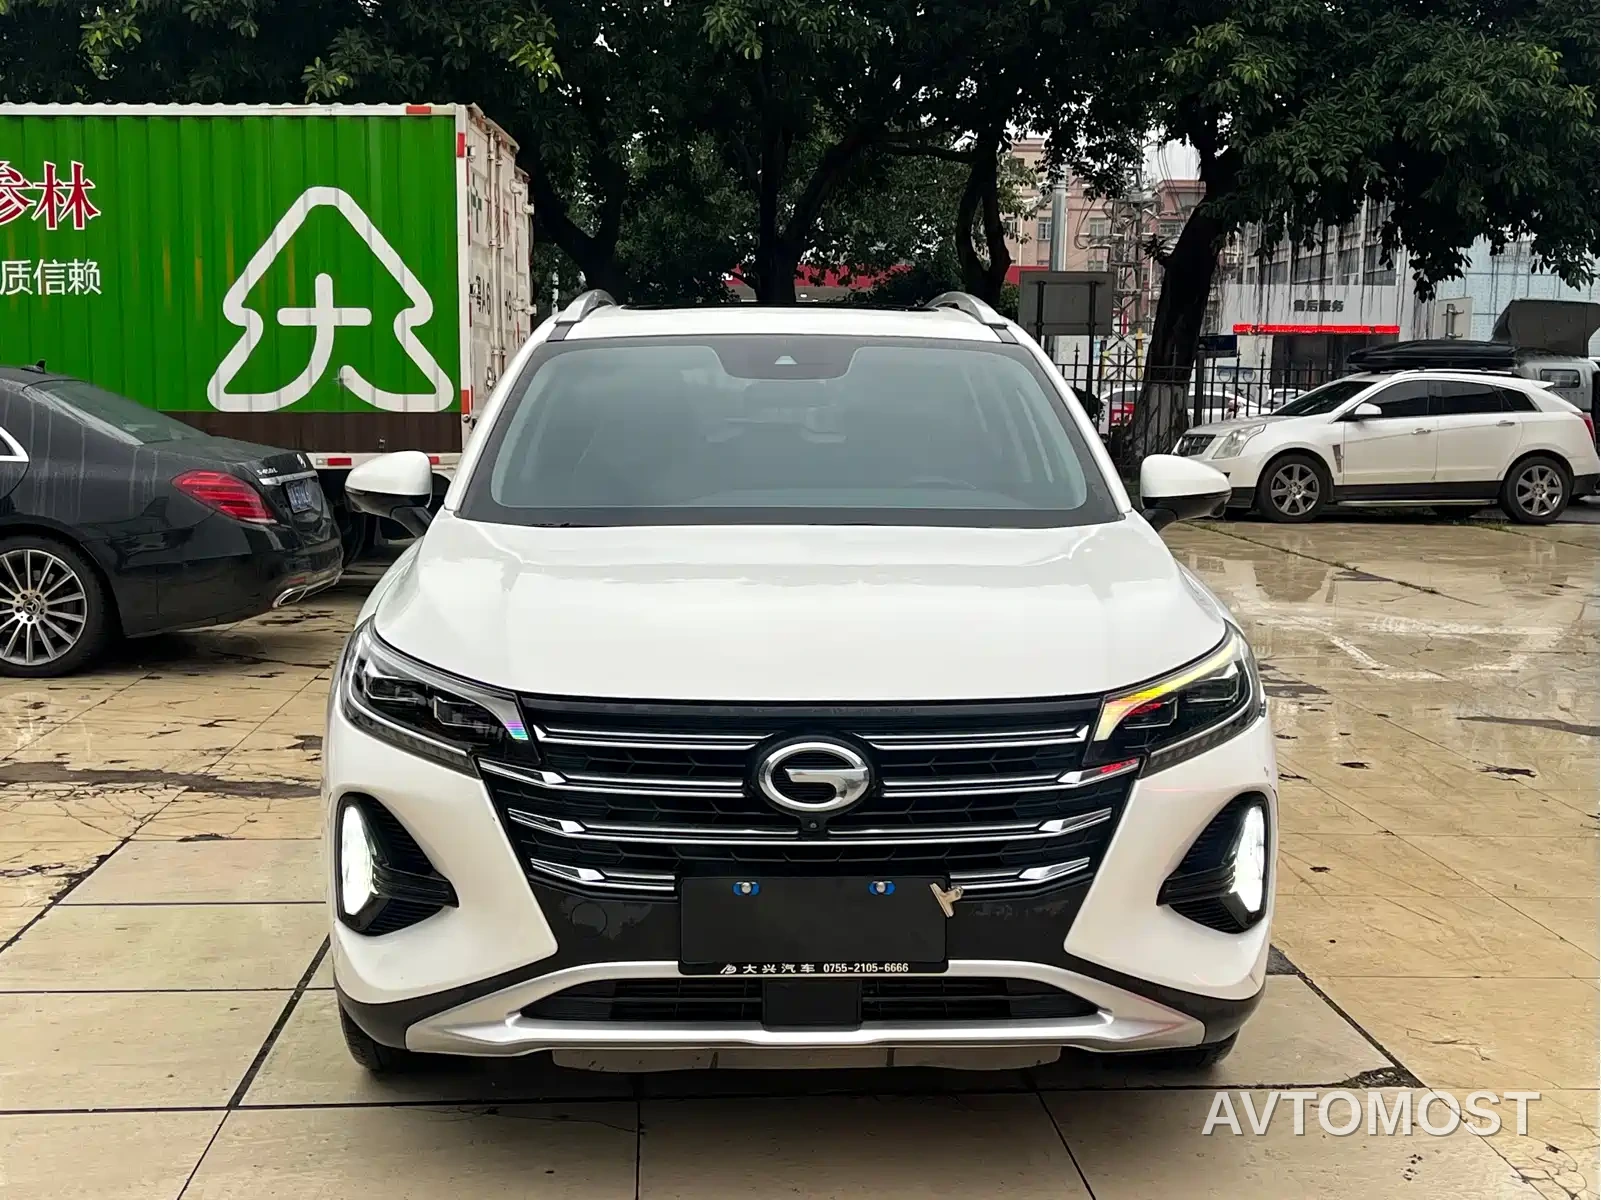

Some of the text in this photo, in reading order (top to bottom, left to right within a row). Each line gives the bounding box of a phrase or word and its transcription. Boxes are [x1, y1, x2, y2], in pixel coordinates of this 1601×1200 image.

[0, 258, 102, 296] 质信赖
[743, 962, 909, 974] 大兴汽车 0755-2105-6666
